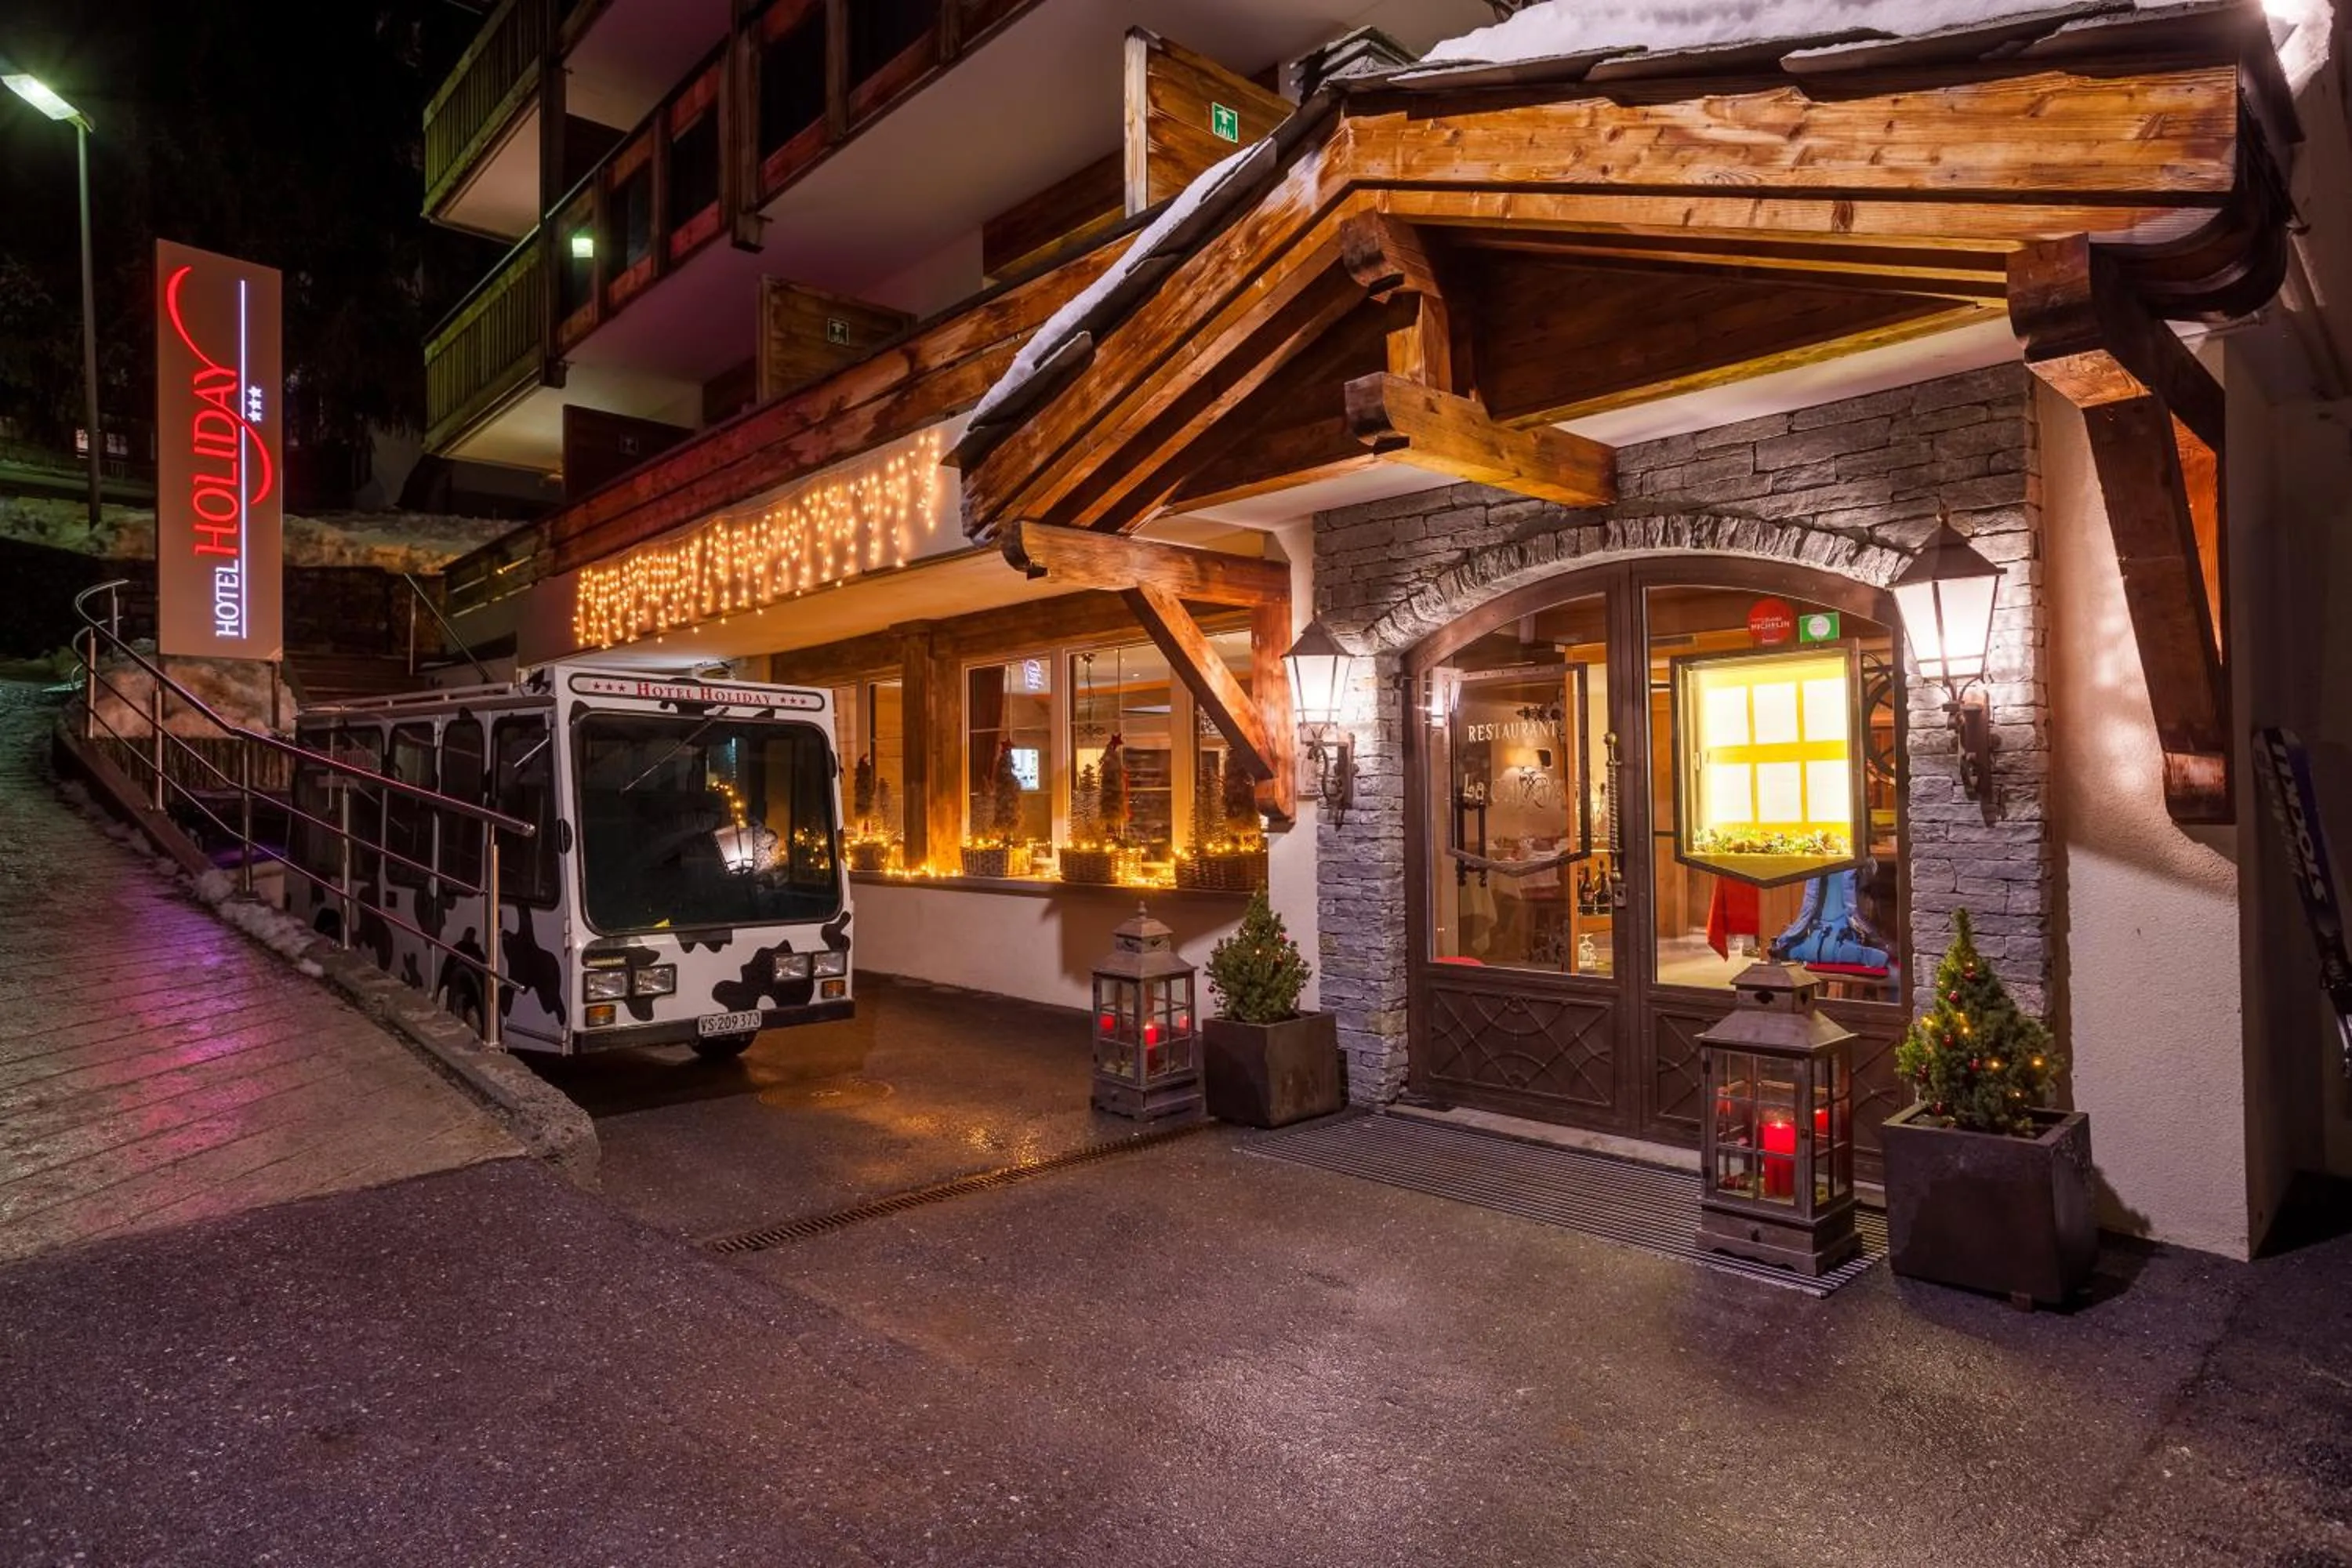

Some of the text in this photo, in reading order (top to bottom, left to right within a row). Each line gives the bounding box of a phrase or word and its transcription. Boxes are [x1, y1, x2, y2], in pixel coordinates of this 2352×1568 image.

[215, 559, 239, 637] HOTEL
[636, 682, 771, 705] HOTEL HOLIDAY
[1468, 720, 1558, 742] RESTAURANT
